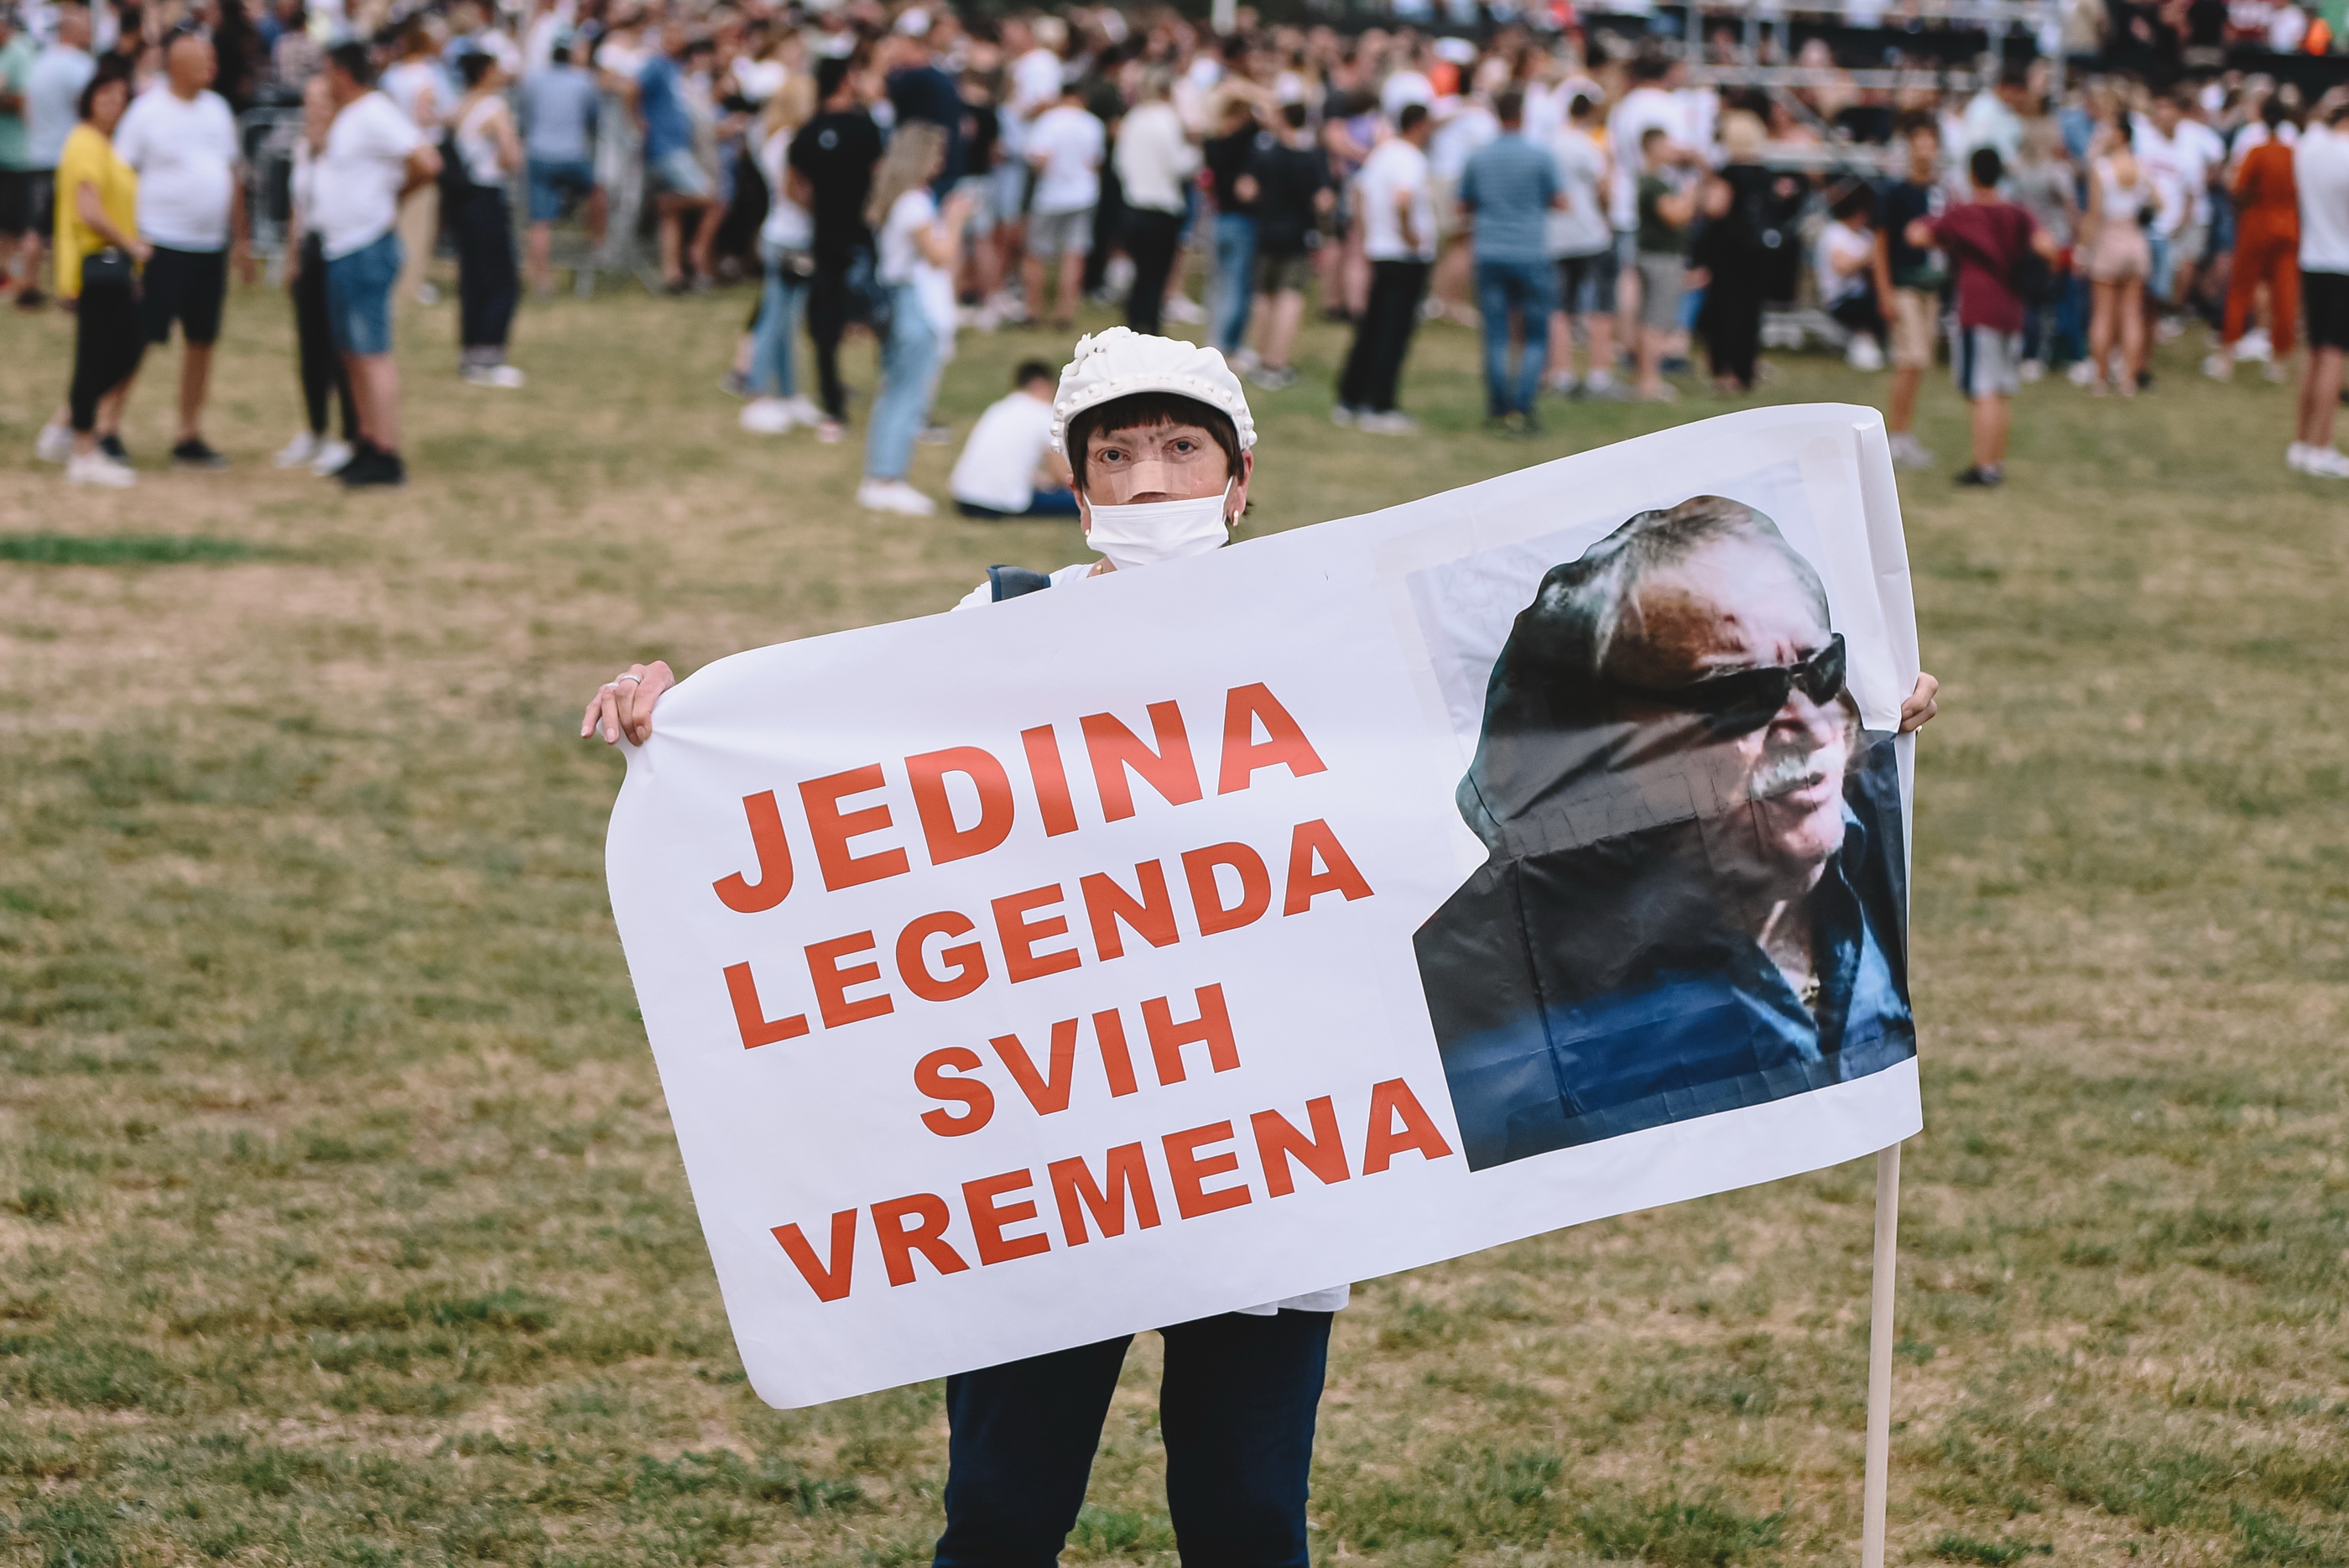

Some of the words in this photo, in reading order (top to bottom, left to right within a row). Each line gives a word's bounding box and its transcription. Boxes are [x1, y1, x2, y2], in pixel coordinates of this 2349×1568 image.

[712, 681, 1328, 914] JEDINA
[723, 818, 1374, 1050] LEGENDA
[914, 982, 1242, 1138] SVIH
[771, 1077, 1453, 1303] VREMENA
